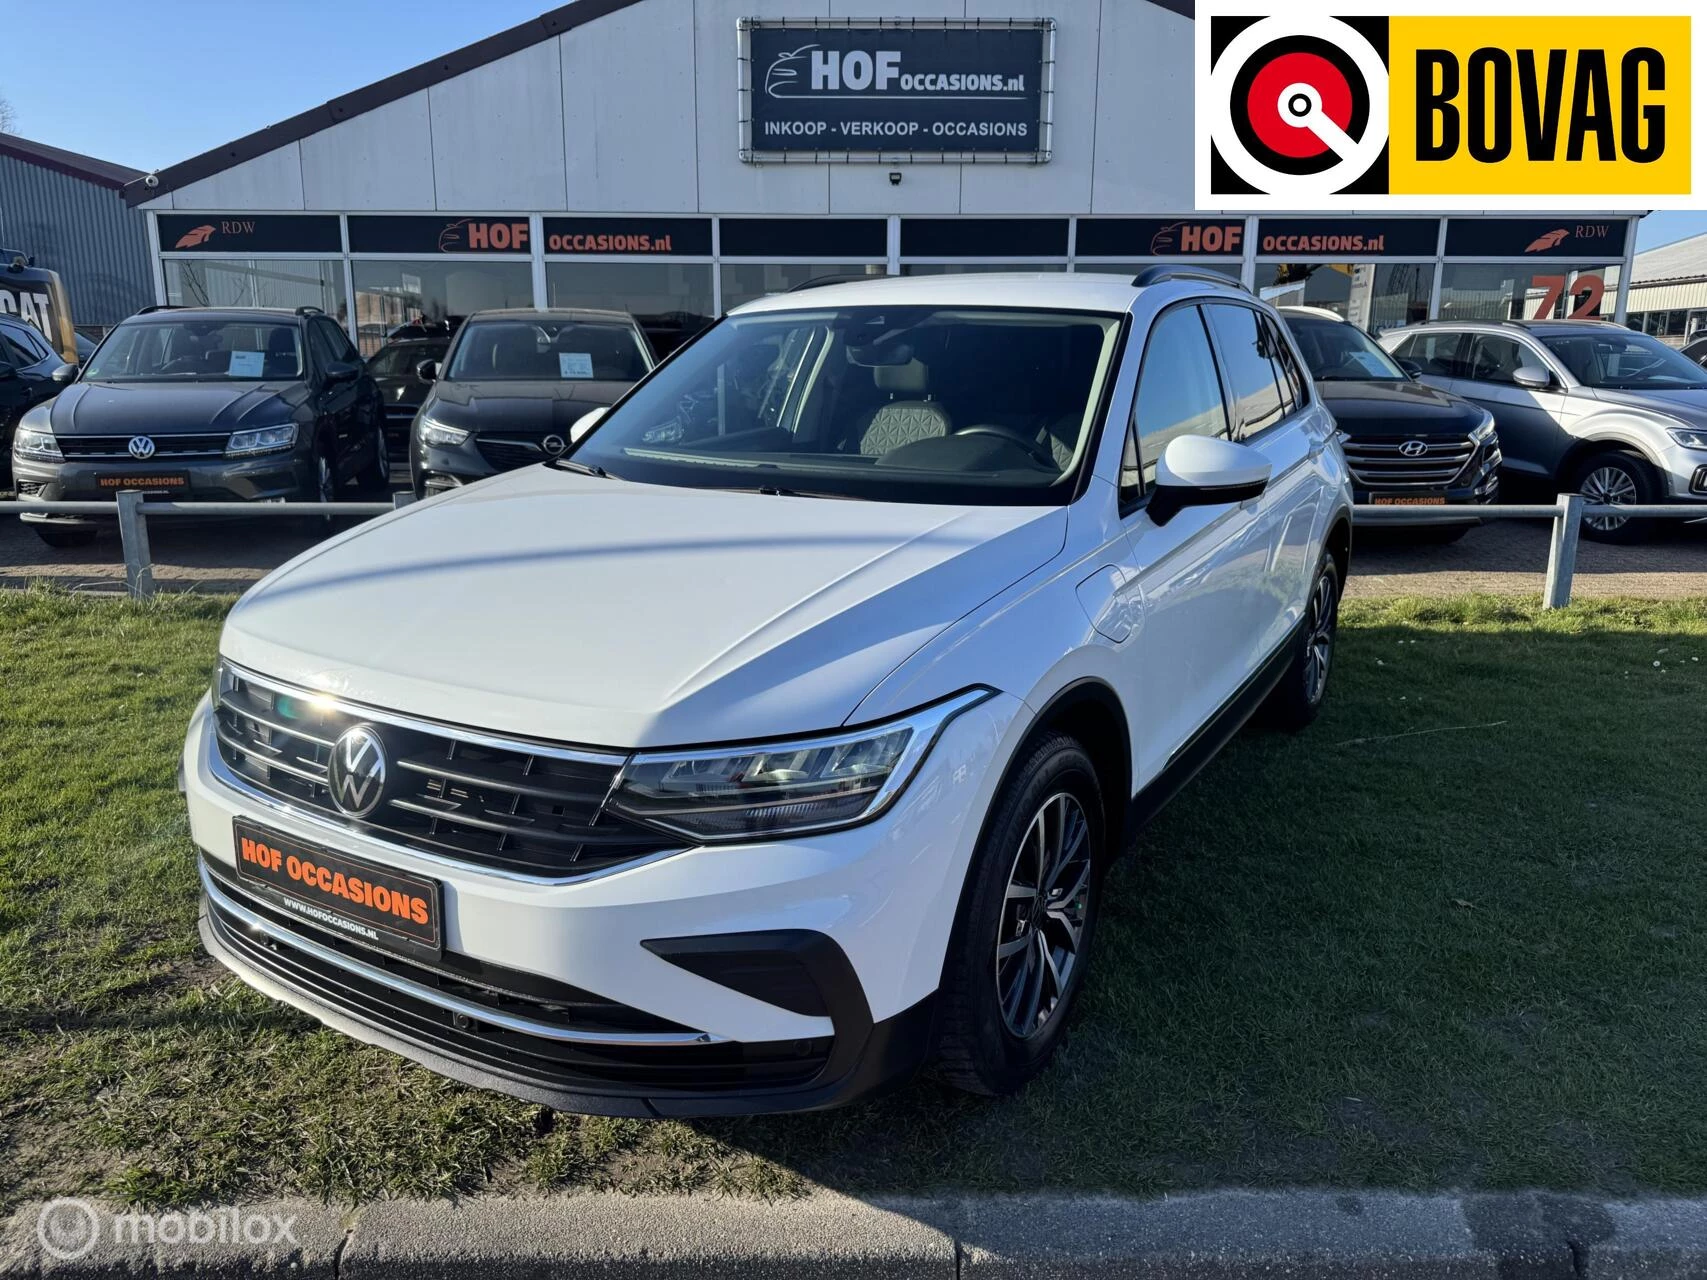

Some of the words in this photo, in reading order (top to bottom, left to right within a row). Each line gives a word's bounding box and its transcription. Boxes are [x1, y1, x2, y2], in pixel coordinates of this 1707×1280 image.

[811, 51, 901, 91] HOF
[900, 73, 1025, 92] OCCASIONS.nl
[764, 121, 827, 136] INKOOP
[840, 121, 919, 137] VERKOOP
[932, 122, 1028, 137] OCCASIONS
[221, 221, 256, 234] RDW
[468, 223, 529, 249] HOF
[549, 234, 672, 251] OCCASIONS.nl
[1180, 226, 1242, 252] HOF
[1262, 234, 1385, 251] OCCASIONS.nl
[1575, 225, 1609, 238] RDW
[1531, 274, 1605, 320] 72
[100, 478, 120, 487] HOF
[123, 477, 184, 487] OCCASIONS
[241, 837, 282, 872] HOF
[286, 855, 429, 925] OCCASIONS
[283, 897, 380, 940] WWW.HOFOCCASIONS.NL
